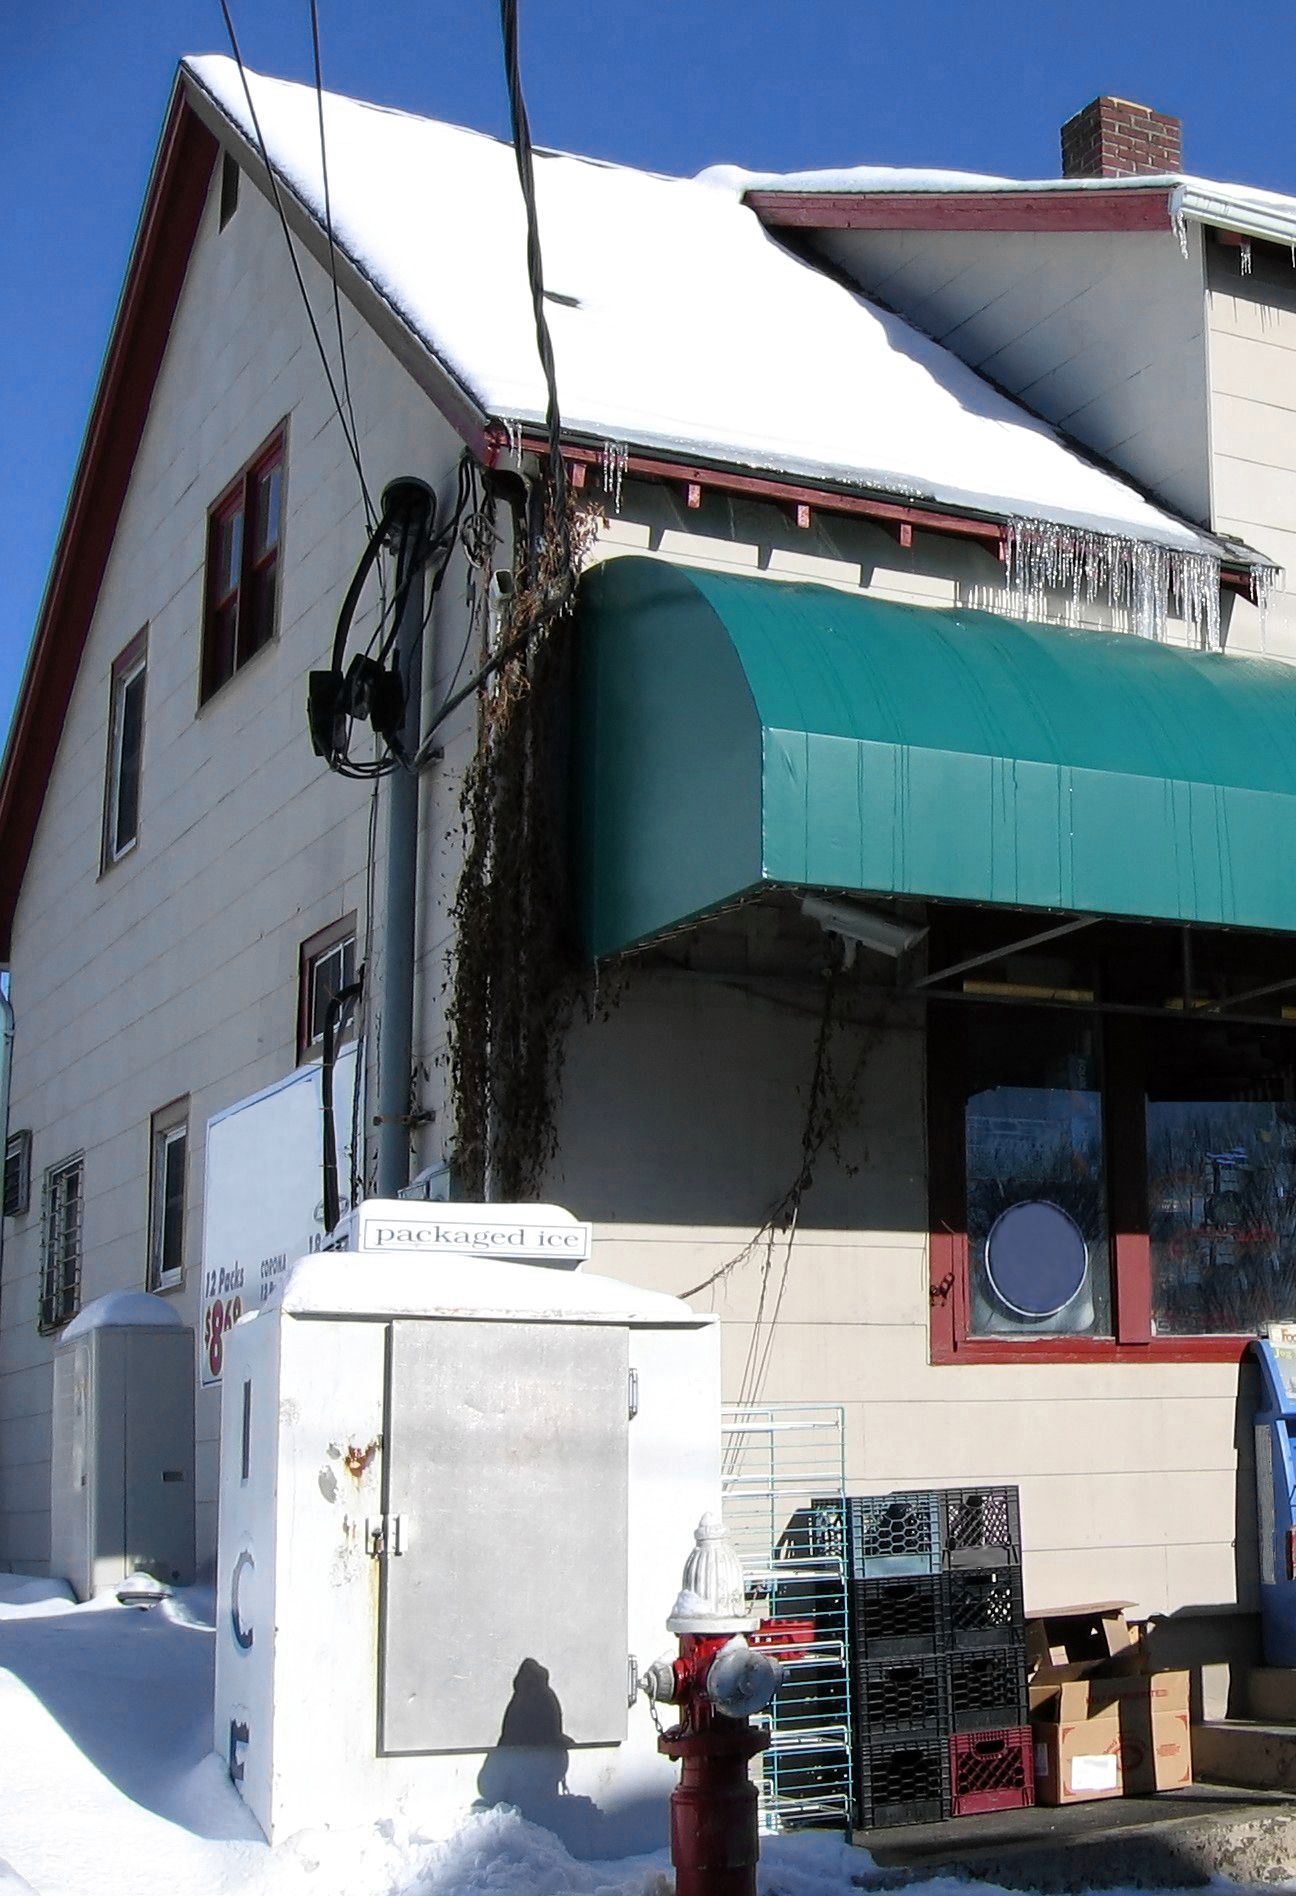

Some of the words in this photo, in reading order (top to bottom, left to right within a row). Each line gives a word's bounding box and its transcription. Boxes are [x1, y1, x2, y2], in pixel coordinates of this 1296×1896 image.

[376, 1225, 526, 1249] packaged
[537, 1230, 579, 1248] ice
[205, 1269, 217, 1298] 12
[218, 1260, 245, 1294] Packs
